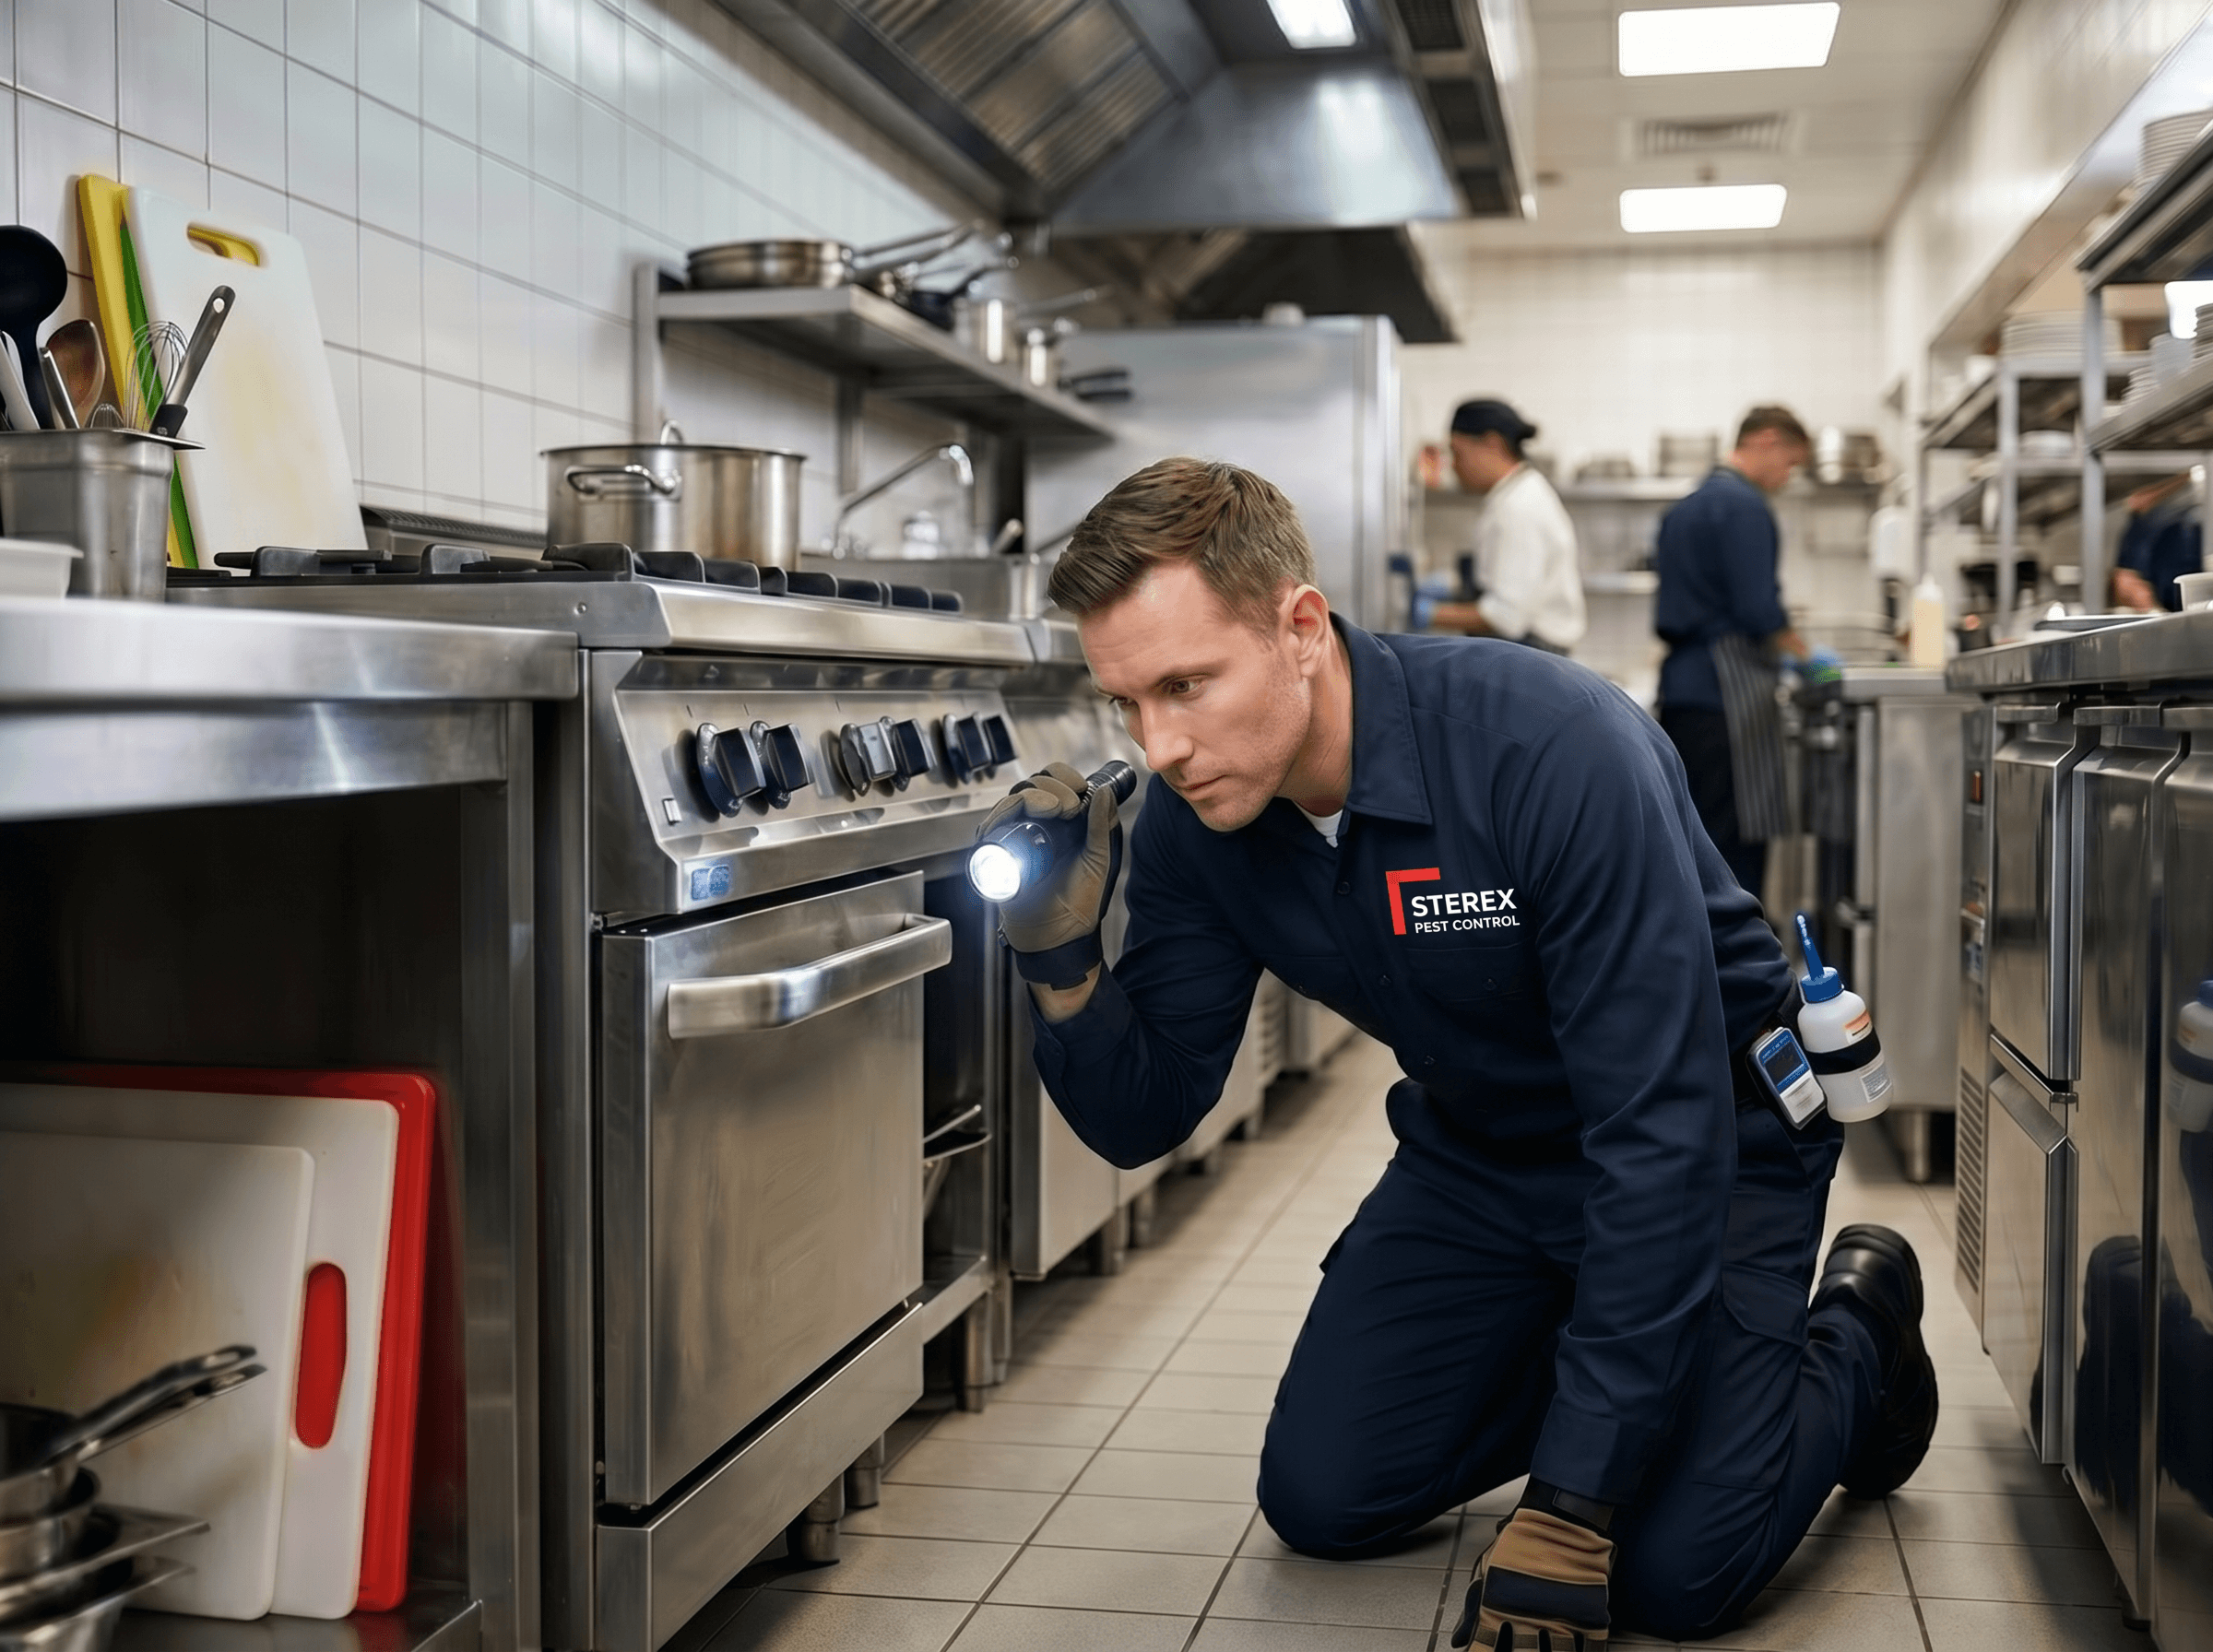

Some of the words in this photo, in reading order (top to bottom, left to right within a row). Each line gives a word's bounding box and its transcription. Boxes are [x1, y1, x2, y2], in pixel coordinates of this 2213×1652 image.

[1411, 889, 1517, 916] STEREX
[1414, 921, 1449, 933] PEST
[1452, 915, 1520, 931] CONTROL
